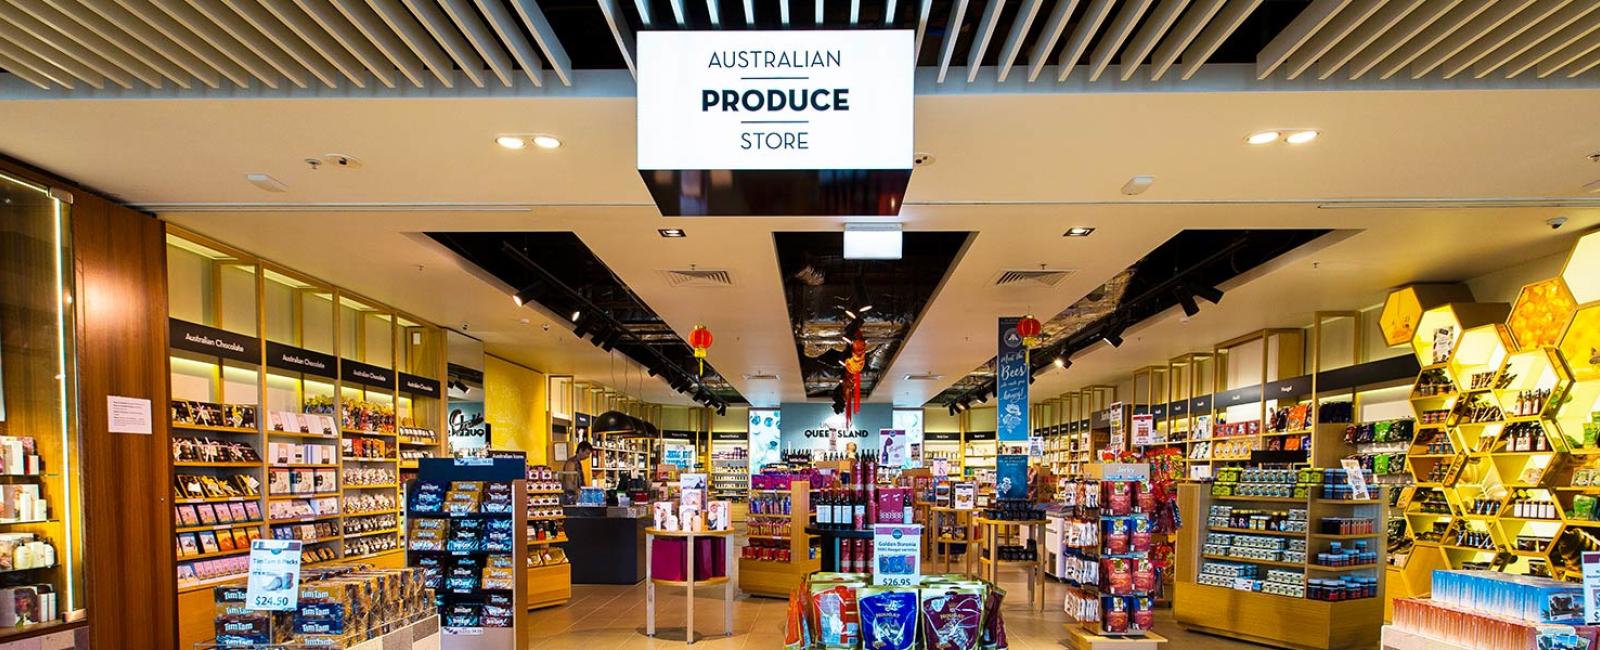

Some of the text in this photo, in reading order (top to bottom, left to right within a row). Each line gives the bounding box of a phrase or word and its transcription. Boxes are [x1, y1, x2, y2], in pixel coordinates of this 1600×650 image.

[708, 49, 841, 68] AUSTRALIAN
[701, 88, 850, 112] PRODUCE
[740, 132, 809, 150] STORE
[185, 332, 245, 352] Australian Chocolate
[282, 353, 326, 369] Australian Chocolate
[1001, 363, 1026, 380] Bees
[804, 429, 869, 438] QUEESLAND
[882, 577, 911, 586] $26.95
[255, 596, 289, 606] $24.50
